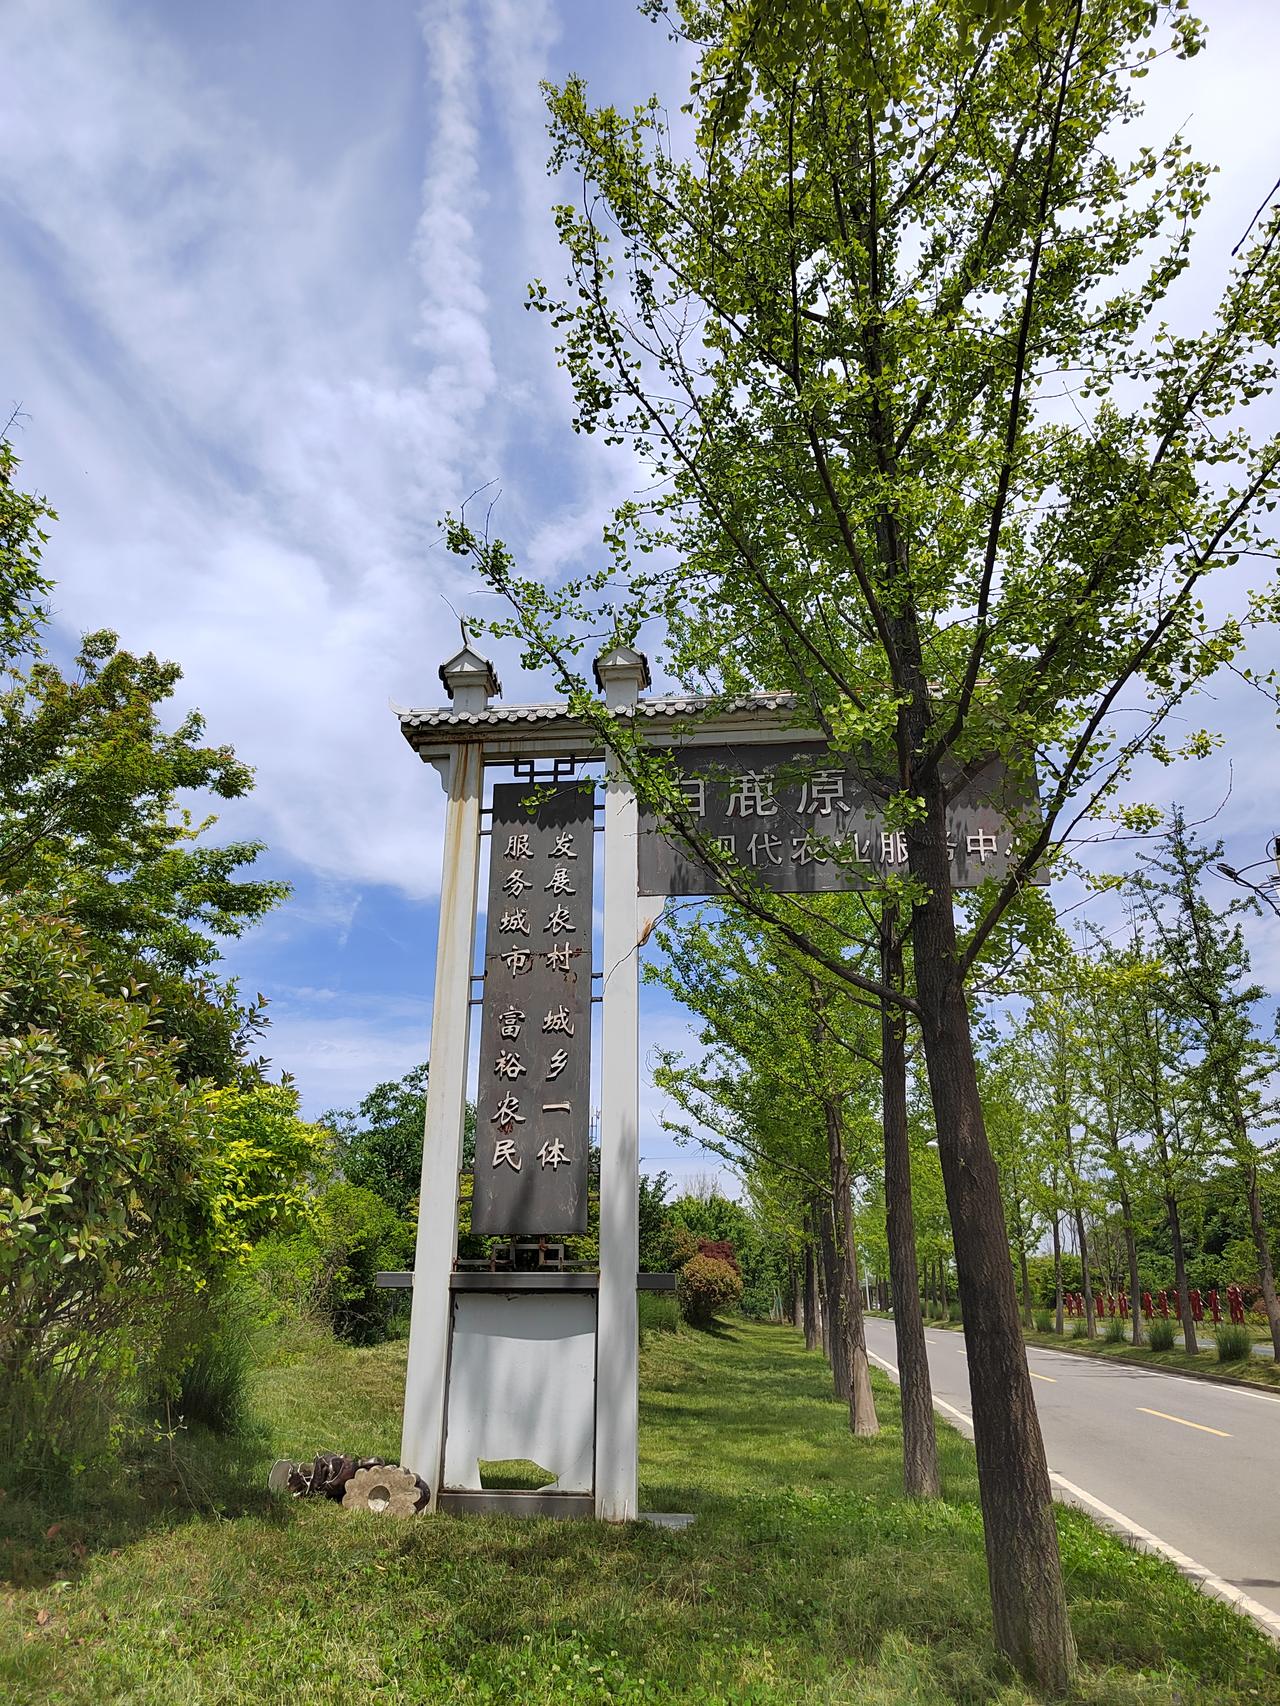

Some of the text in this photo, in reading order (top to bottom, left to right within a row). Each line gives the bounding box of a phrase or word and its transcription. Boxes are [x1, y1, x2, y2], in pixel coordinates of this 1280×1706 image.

[669, 769, 851, 817] 白鹿原
[704, 828, 1023, 866] 代农业服中
[491, 834, 534, 1172] 服务城市 富裕农民
[537, 832, 578, 1170] 发展农村 城乡一体
